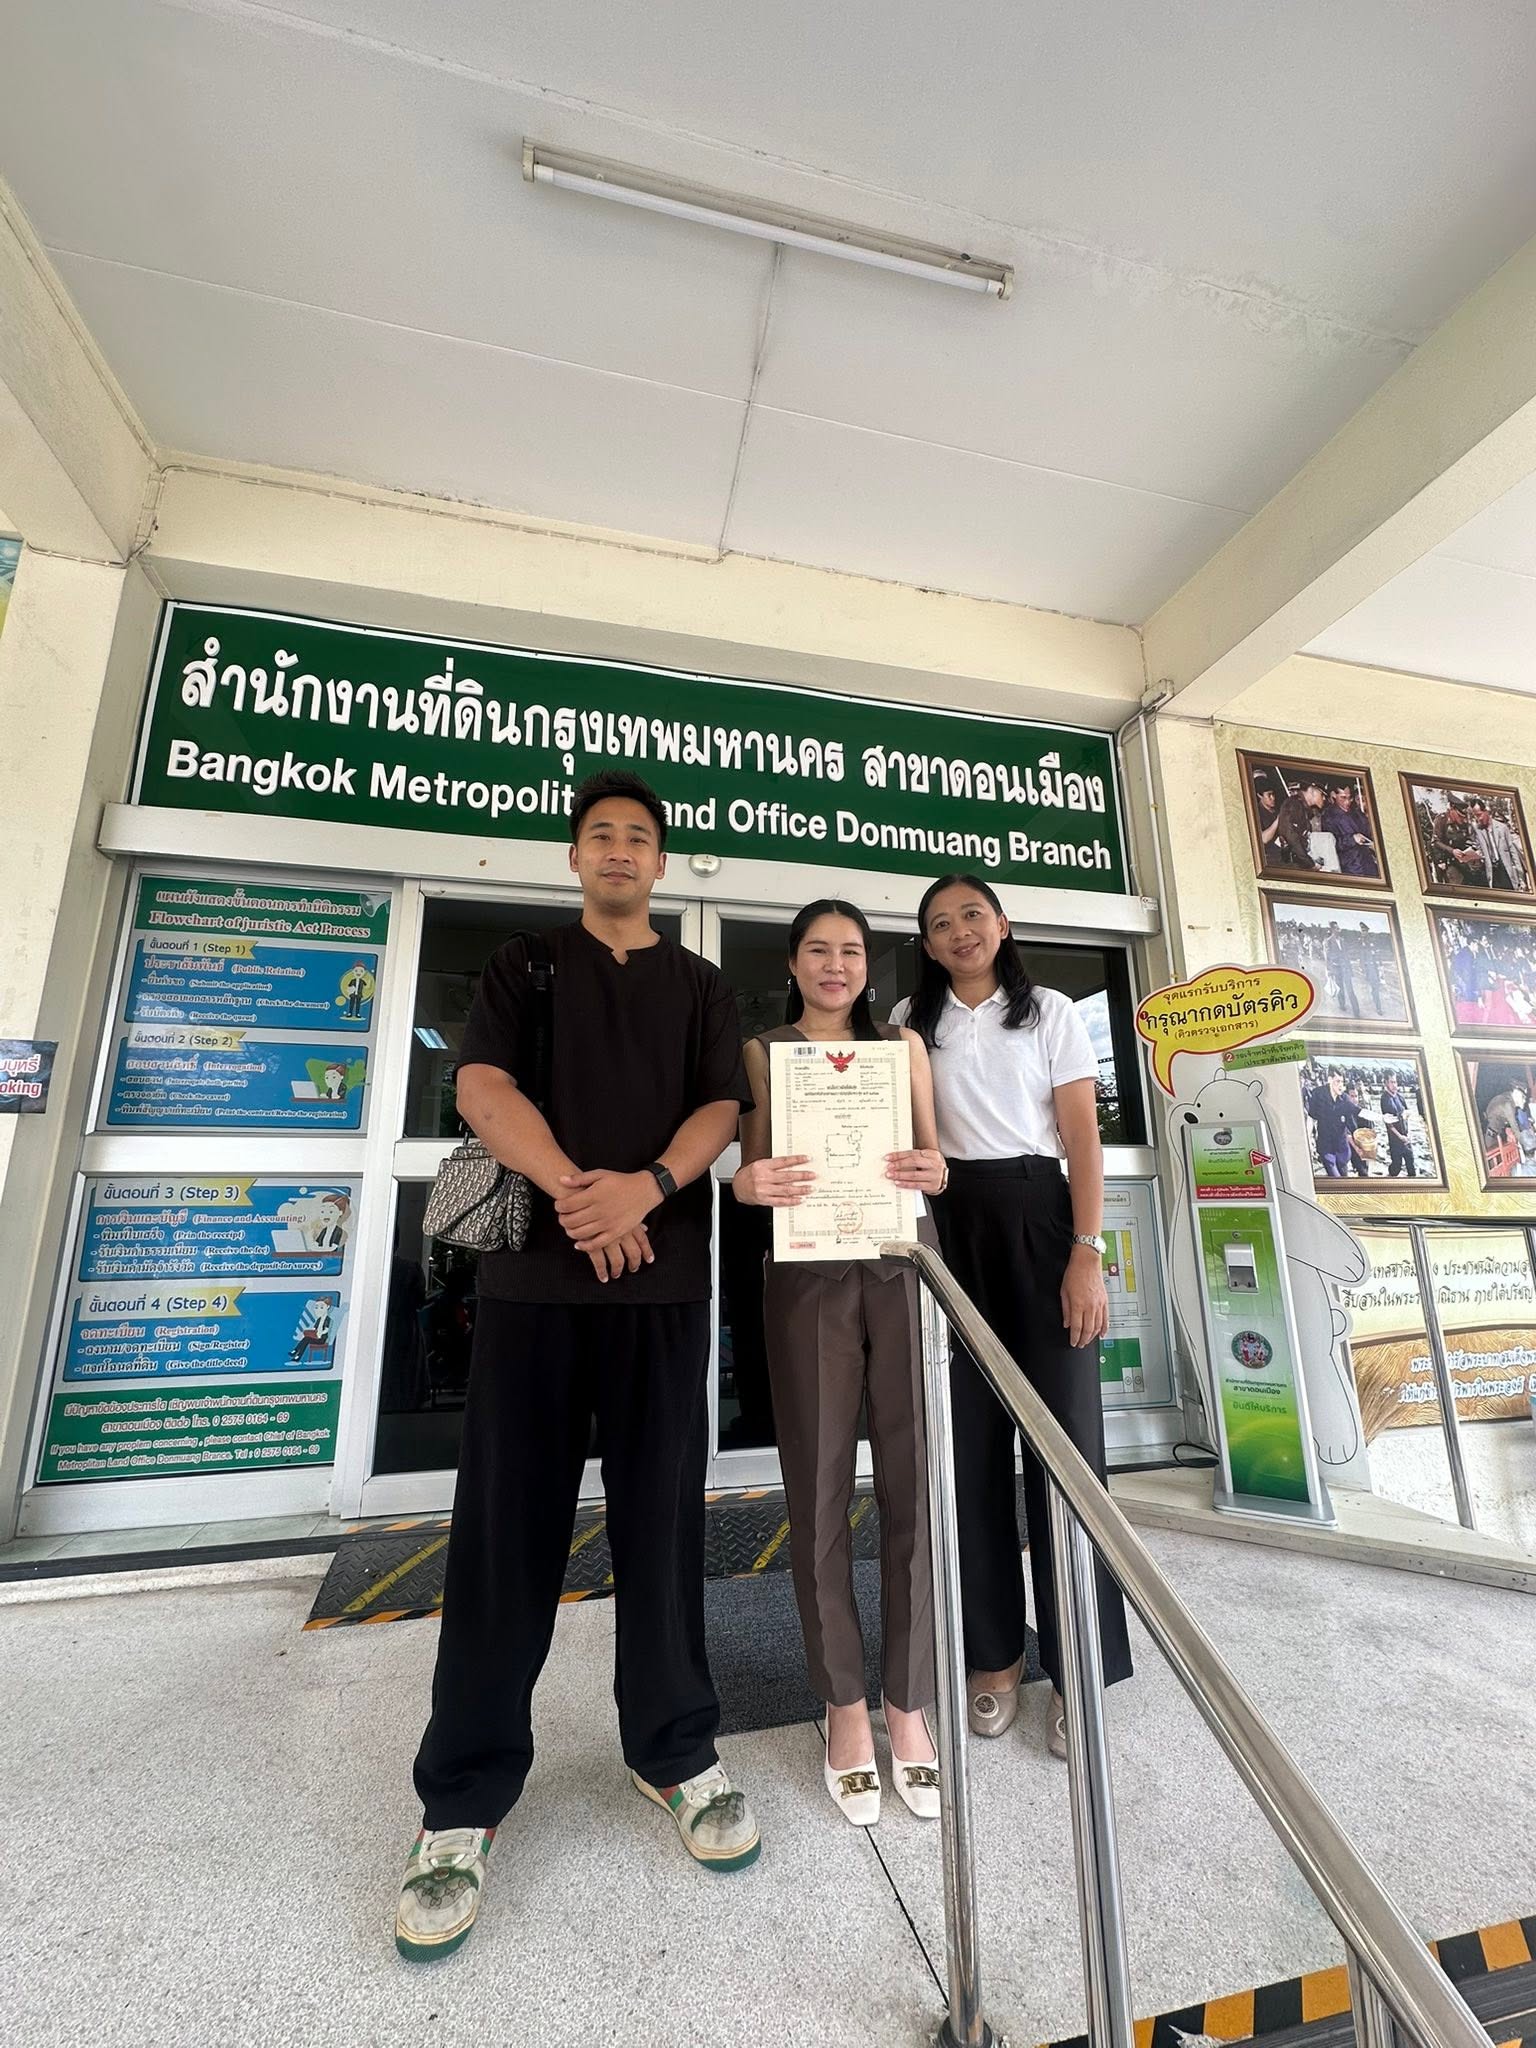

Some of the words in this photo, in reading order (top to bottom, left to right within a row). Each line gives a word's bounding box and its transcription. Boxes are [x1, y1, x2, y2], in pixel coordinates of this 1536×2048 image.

[180, 635, 845, 782] สำนักงานที่ดินกรุงเทพมหานคร
[861, 744, 1107, 814] สาขาดอนเมือง
[166, 738, 357, 797] Bangkok
[369, 762, 575, 818] Metropolit
[661, 797, 716, 831] and
[728, 798, 827, 840] Office
[836, 810, 1001, 867] Donmuang
[1008, 831, 1112, 870] Branch
[157, 888, 361, 916] แผนผังแสดงขั้นตอนการทำนิติกรรม
[149, 910, 224, 928] Flowchart
[225, 916, 240, 928] of
[240, 917, 292, 932] juristic
[292, 920, 319, 934] Act
[319, 922, 371, 938] Process
[149, 937, 190, 950] ขั้นตอนที่
[203, 942, 232, 954] (Step
[235, 945, 246, 954] 1)
[144, 954, 226, 972] ประชาสัมพันธ์
[231, 964, 264, 974] (Public
[264, 966, 306, 978] Relation)
[1163, 977, 1260, 1005] จุดแรกรับบริการ
[1147, 989, 1298, 1036] กรุณากดบัตรคิว
[134, 1031, 176, 1044] ขั้นตอนที่
[178, 1035, 185, 1044] 2
[189, 1034, 219, 1047] (Step
[221, 1036, 233, 1047] 2)
[104, 1183, 159, 1200] ขั้นตอนที่
[165, 1187, 174, 1198] 3
[180, 1186, 218, 1201] (Step
[222, 1186, 240, 1201] 3)
[96, 1208, 188, 1227] การเงินและบัญชี
[192, 1214, 233, 1225] (Finance
[234, 1214, 252, 1223] and
[252, 1214, 307, 1224] Accounting)
[101, 1226, 165, 1241] พิมพ์ใบเสร็จ
[196, 1230, 212, 1240] the
[213, 1230, 245, 1241] receipt)
[99, 1242, 198, 1257] รับเงินค่าธรรมเนียม
[204, 1246, 239, 1257] (Receive
[239, 1246, 254, 1255] the
[254, 1245, 270, 1256] fee)
[96, 1259, 195, 1274] รับเงินค่ามัดจำรังวัด
[200, 1262, 238, 1273] (Receive
[238, 1262, 250, 1271] the
[250, 1262, 279, 1272] deposit
[1443, 1256, 1530, 1280] ประชาชนมีความสุ
[89, 1294, 146, 1313] ขั้นตอนที่
[151, 1298, 161, 1310] 4
[166, 1296, 207, 1313] (Step
[211, 1295, 228, 1310] 4)
[1474, 1282, 1533, 1305] ภายใต้ปรัชญ
[80, 1322, 146, 1340] จดทะเบียน
[154, 1323, 220, 1338] (Registration)
[85, 1338, 181, 1355] ลงนาม/จดทะเบียน
[187, 1339, 250, 1352] (Sign/Register)
[82, 1353, 158, 1374] แจกโฉนดที่ดิน
[165, 1359, 190, 1371] (Give
[190, 1359, 206, 1369] the
[206, 1358, 222, 1369] title
[223, 1357, 248, 1368] deed)
[1233, 1385, 1281, 1395] สาขาดอนเมือง
[1232, 1400, 1288, 1414] ยินดีให้บริการ
[101, 1418, 162, 1433] สาขาดอนเมือง
[163, 1416, 191, 1429] ติดต่อ
[191, 1413, 211, 1428] โทร.
[212, 1415, 220, 1426] 0
[221, 1414, 244, 1426] 2575
[245, 1413, 269, 1425] 0164
[276, 1412, 290, 1423] 69
[50, 1444, 58, 1455] If
[58, 1445, 77, 1456] you
[77, 1442, 99, 1454] have
[99, 1442, 117, 1453] any
[152, 1436, 198, 1449] concerning
[204, 1434, 231, 1447] please
[232, 1432, 263, 1444] contact
[263, 1431, 285, 1441] Chief
[285, 1430, 296, 1440] of
[296, 1428, 331, 1440] Bangkok
[106, 1456, 130, 1467] Land
[130, 1455, 156, 1467] Office
[156, 1453, 201, 1464] Donmuang
[234, 1448, 247, 1459] Tel
[254, 1447, 260, 1458] 0
[261, 1446, 282, 1457] 2575
